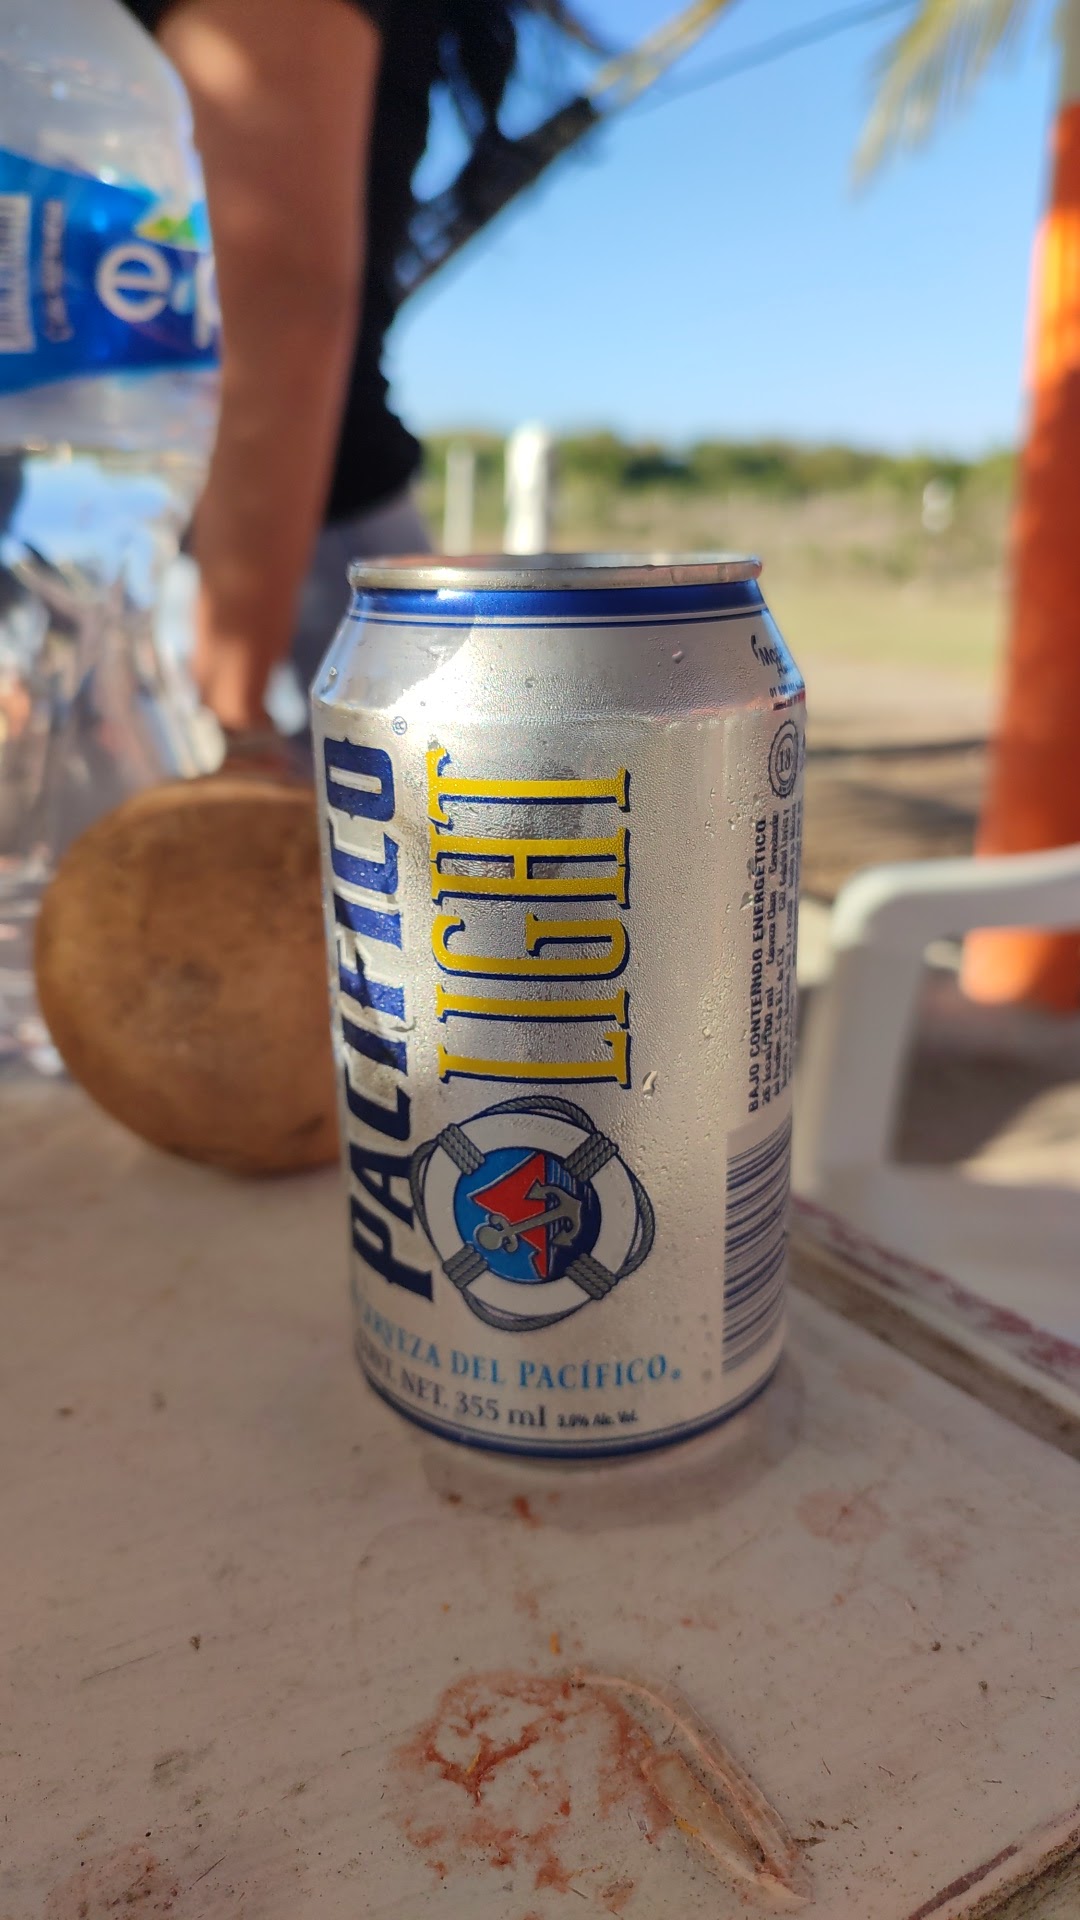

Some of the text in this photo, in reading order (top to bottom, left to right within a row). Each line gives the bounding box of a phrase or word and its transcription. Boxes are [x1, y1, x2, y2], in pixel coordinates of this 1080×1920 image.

[426, 748, 631, 1090] LIGHT
[324, 736, 433, 1303] PACIFICO
[750, 947, 763, 1058] CONTENIDO
[748, 1063, 760, 1112] BAJO
[401, 1367, 448, 1408] NET.
[456, 1390, 500, 1421] 355
[508, 1405, 547, 1427] ml
[451, 1350, 505, 1385] DEL
